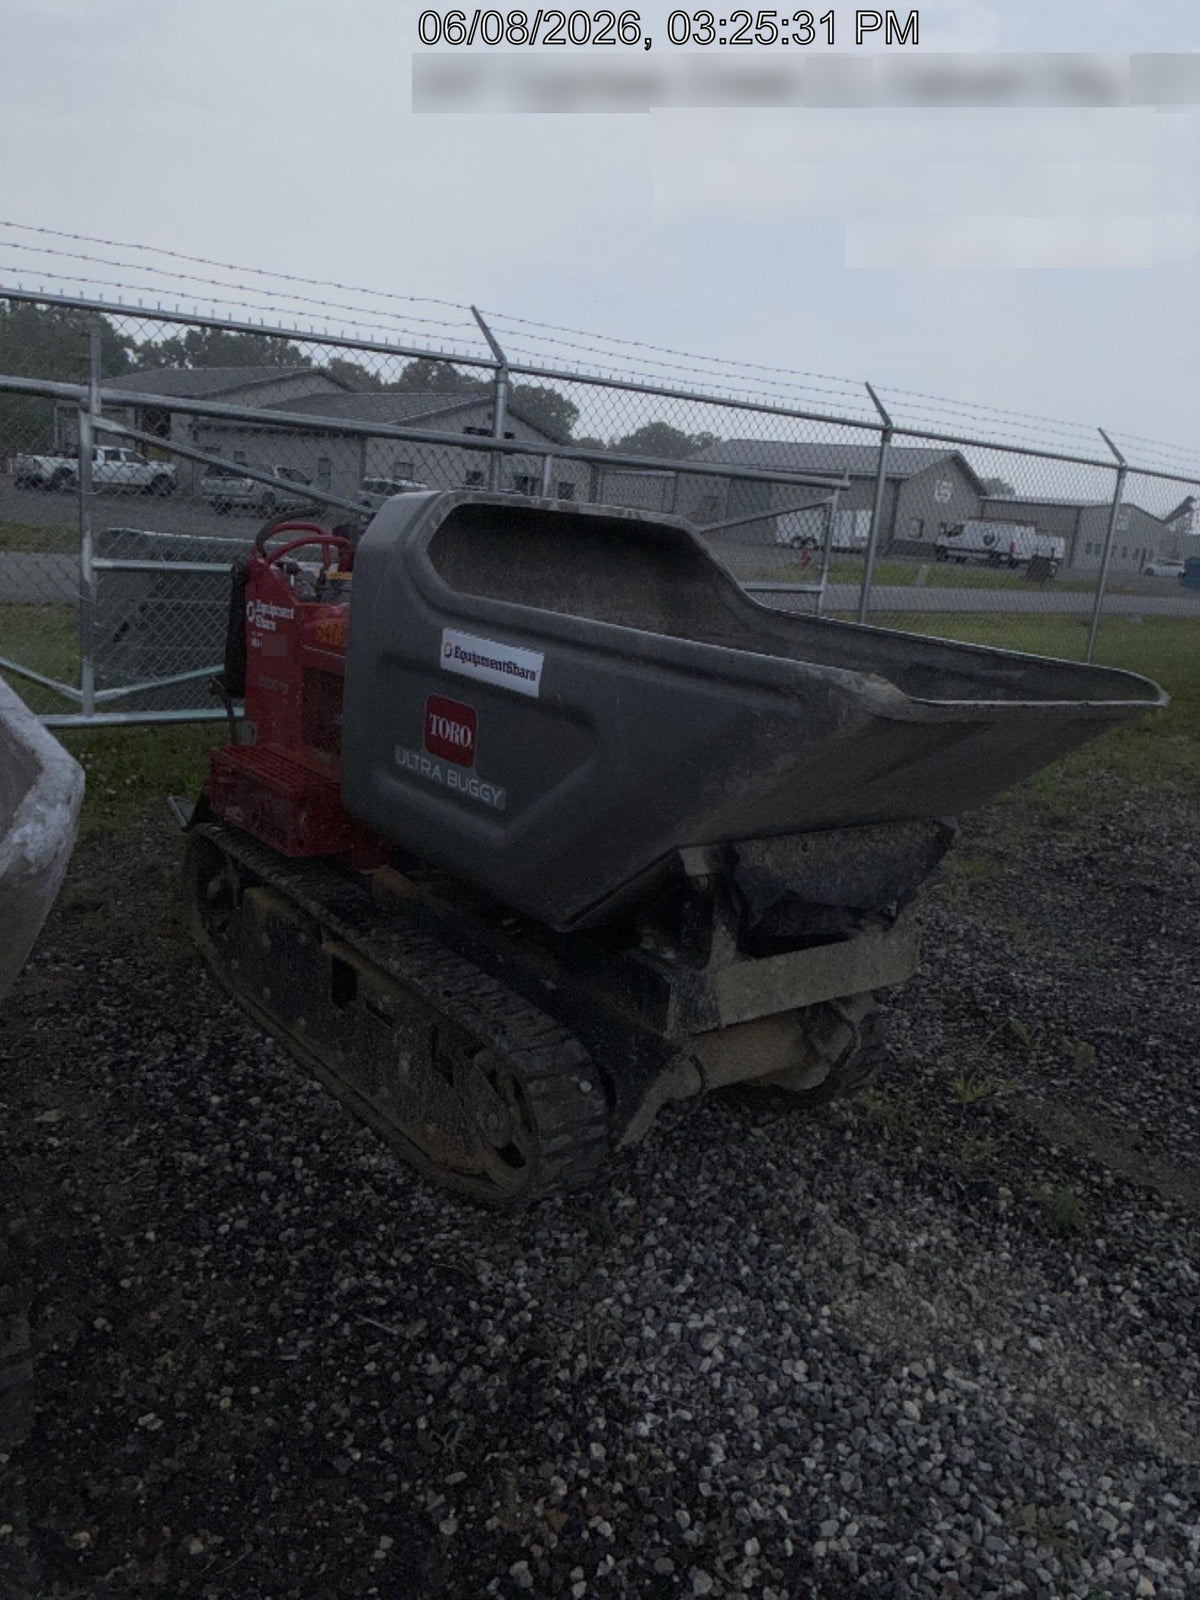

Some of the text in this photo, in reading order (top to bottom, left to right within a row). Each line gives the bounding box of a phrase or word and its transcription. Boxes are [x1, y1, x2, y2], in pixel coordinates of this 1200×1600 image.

[453, 646, 538, 682] EquipmentShare
[429, 713, 473, 748] TORO
[395, 747, 504, 807] ULTRA BUGGY
